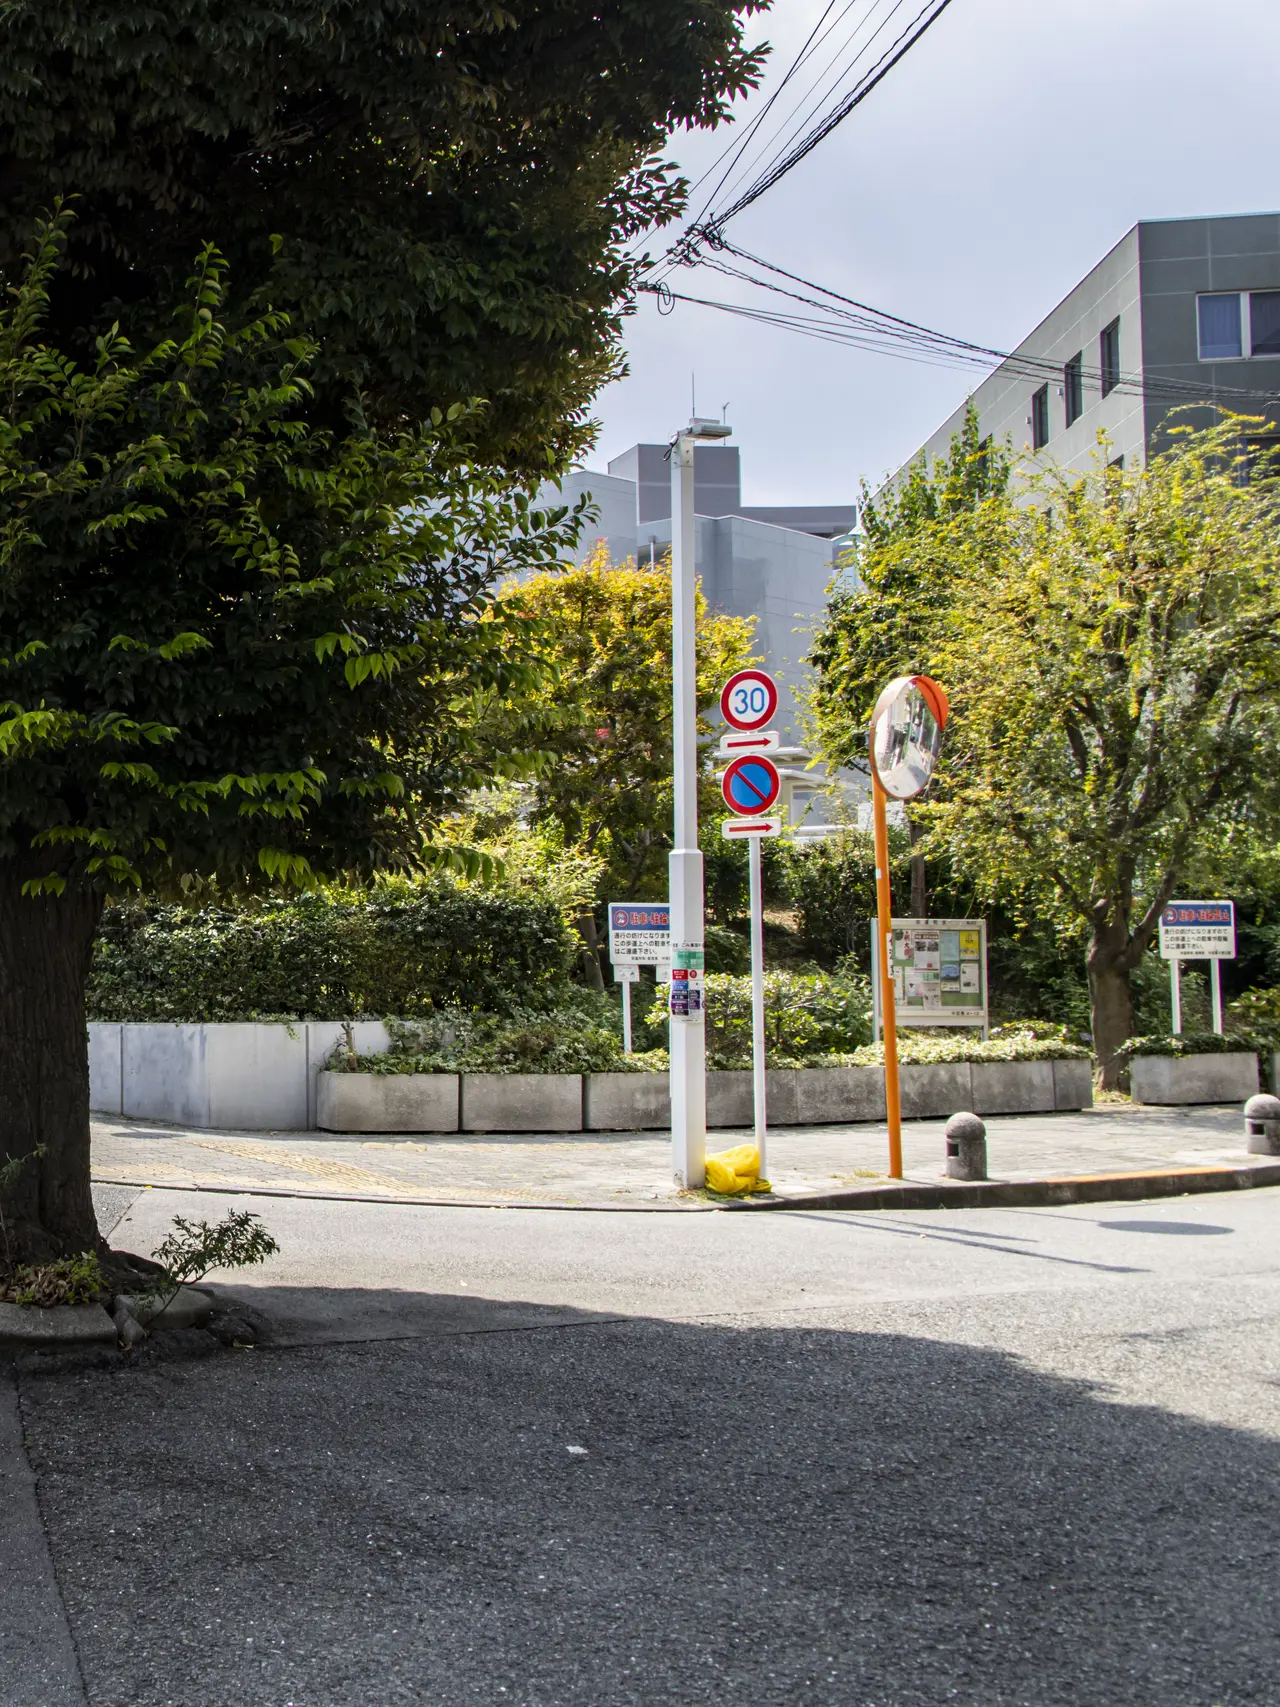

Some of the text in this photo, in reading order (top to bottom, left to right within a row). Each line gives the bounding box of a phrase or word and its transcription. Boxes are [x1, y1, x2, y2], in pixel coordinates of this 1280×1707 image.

[734, 687, 766, 714] 30
[630, 912, 670, 925] 駐車・駐輪
